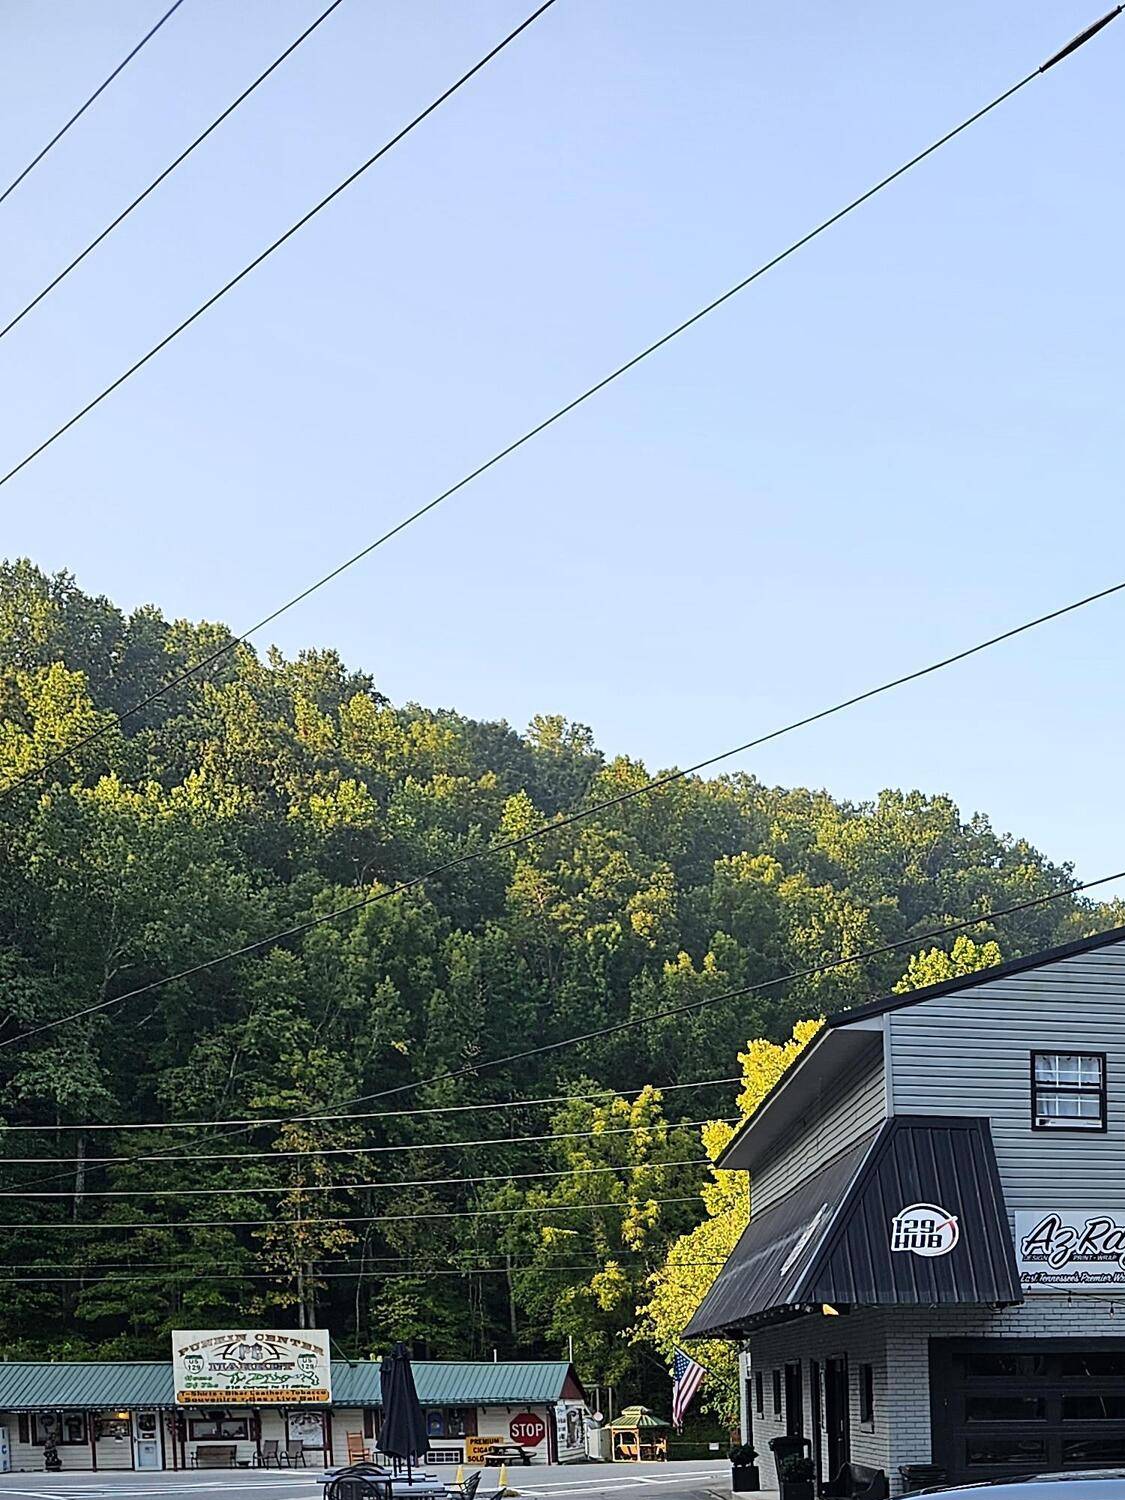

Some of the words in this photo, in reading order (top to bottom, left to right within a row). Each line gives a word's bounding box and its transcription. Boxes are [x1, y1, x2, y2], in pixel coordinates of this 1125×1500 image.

[895, 1219, 936, 1233] 129
[894, 1234, 942, 1248] HUB
[1080, 1272, 1112, 1284] Premier
[511, 1423, 544, 1437] STOP
